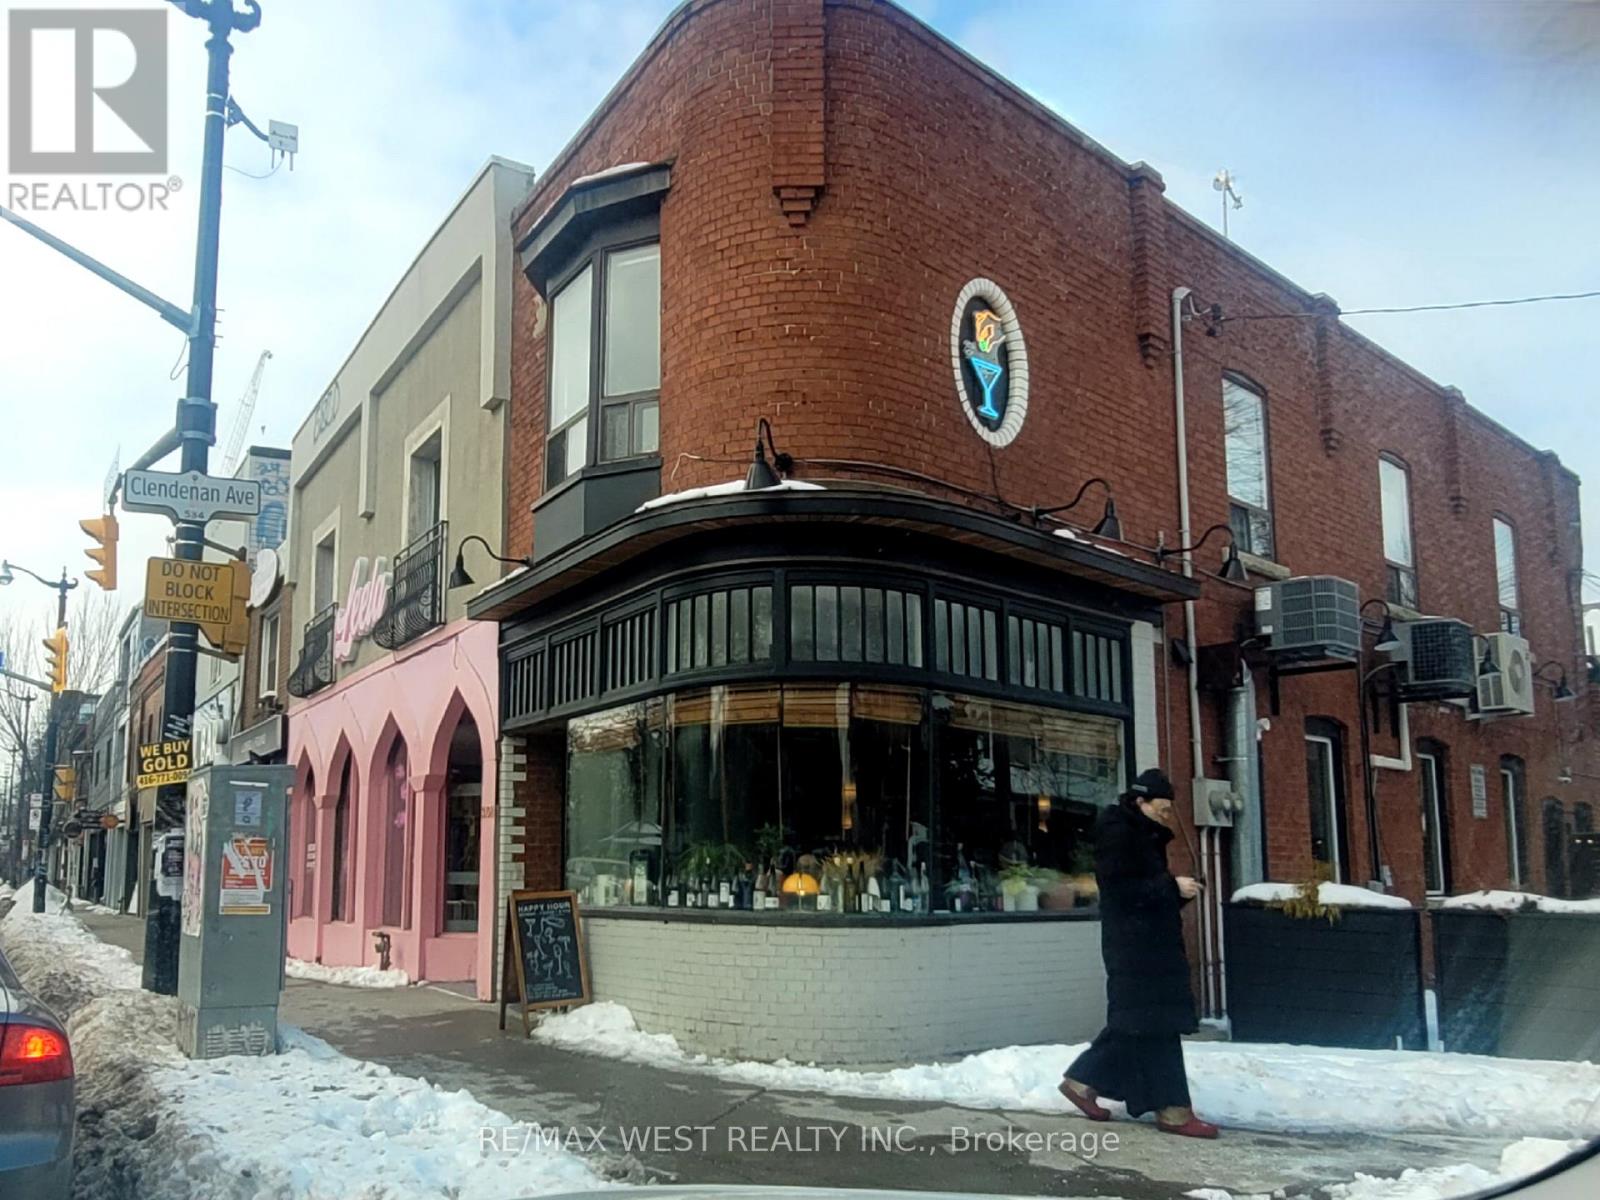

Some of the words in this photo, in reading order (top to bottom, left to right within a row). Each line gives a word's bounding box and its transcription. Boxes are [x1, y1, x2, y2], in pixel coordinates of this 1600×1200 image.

[131, 476, 220, 503] Clendenan
[225, 485, 255, 505] Ave
[161, 561, 185, 578] DO
[190, 564, 220, 582] NOT
[165, 580, 214, 601] BLOCK
[148, 599, 229, 621] INTERSECTION
[140, 744, 160, 758] WE
[163, 739, 190, 755] BUY
[143, 753, 188, 773] GOLD
[518, 903, 544, 913] HAPPY
[547, 901, 570, 911] HOUR
